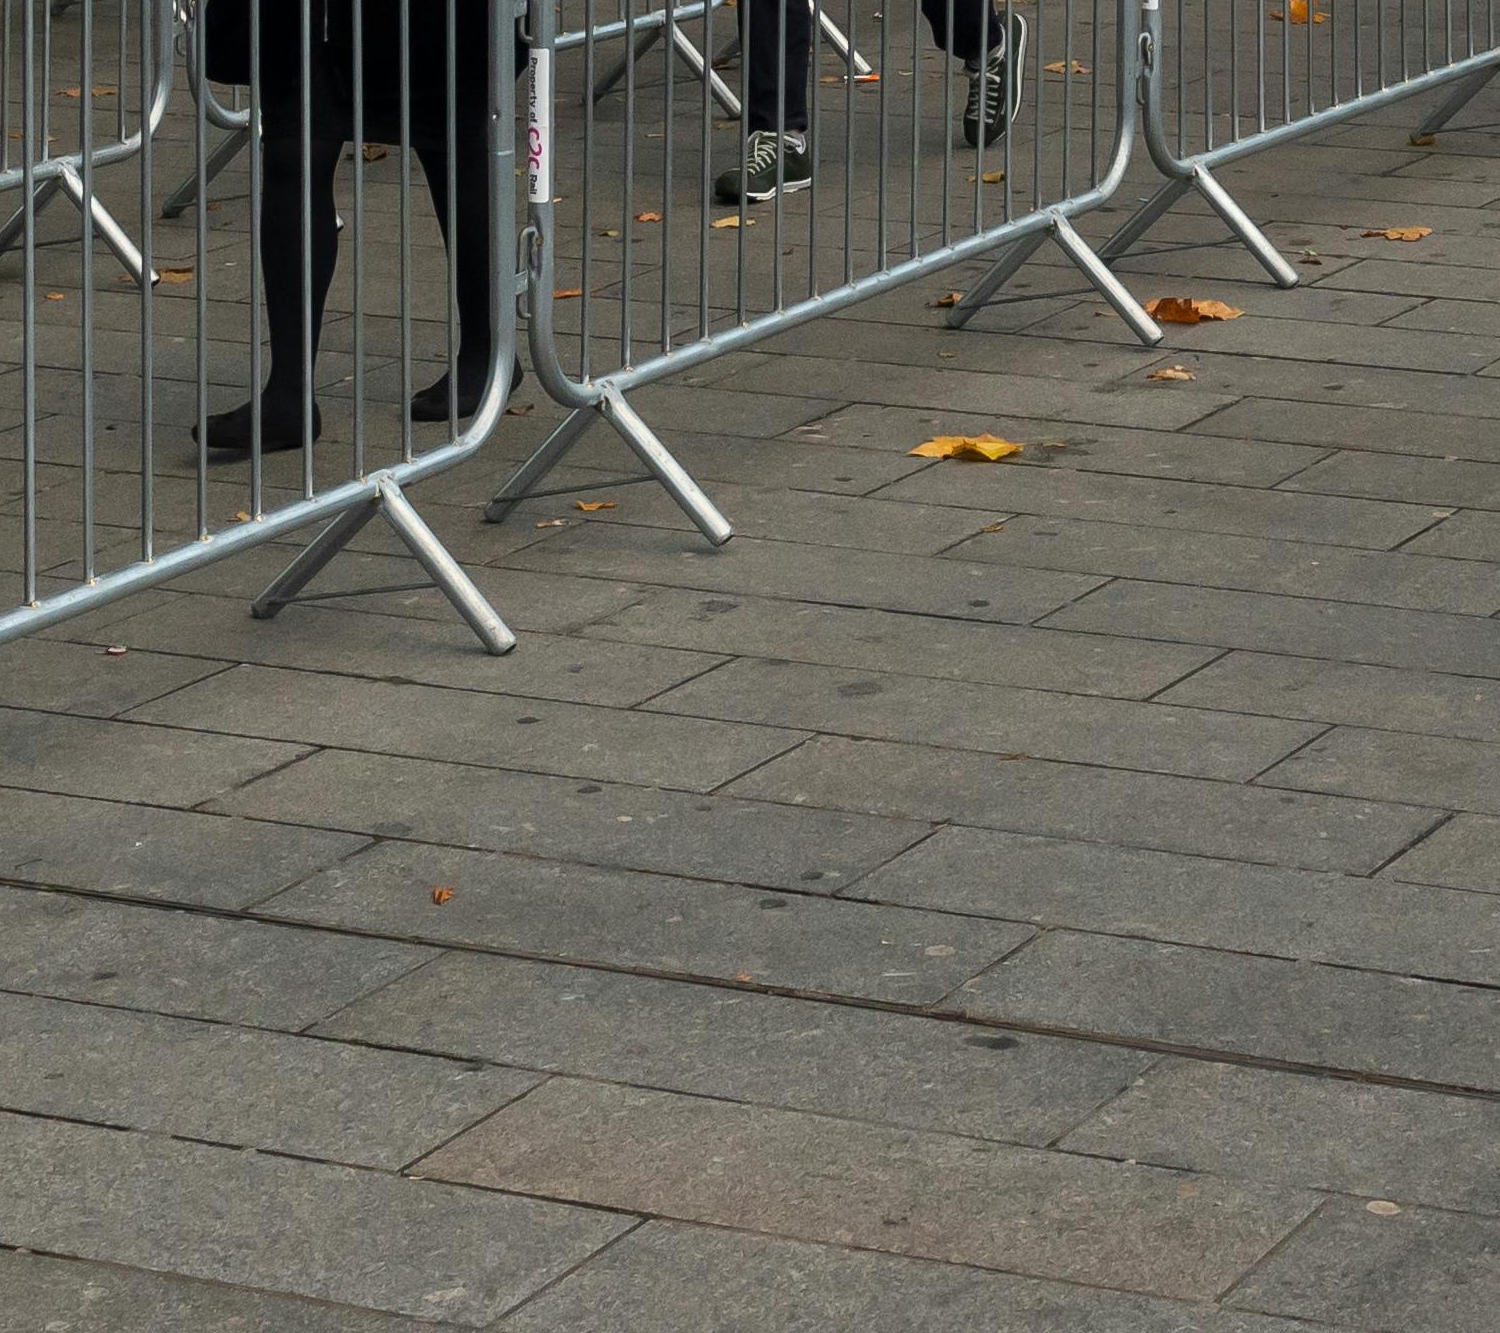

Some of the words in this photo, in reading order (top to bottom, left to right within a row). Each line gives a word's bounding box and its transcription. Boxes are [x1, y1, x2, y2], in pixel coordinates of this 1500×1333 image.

[529, 57, 538, 110] Property
[530, 113, 538, 124] of
[527, 126, 542, 171] c2c
[529, 173, 538, 195] Rail
